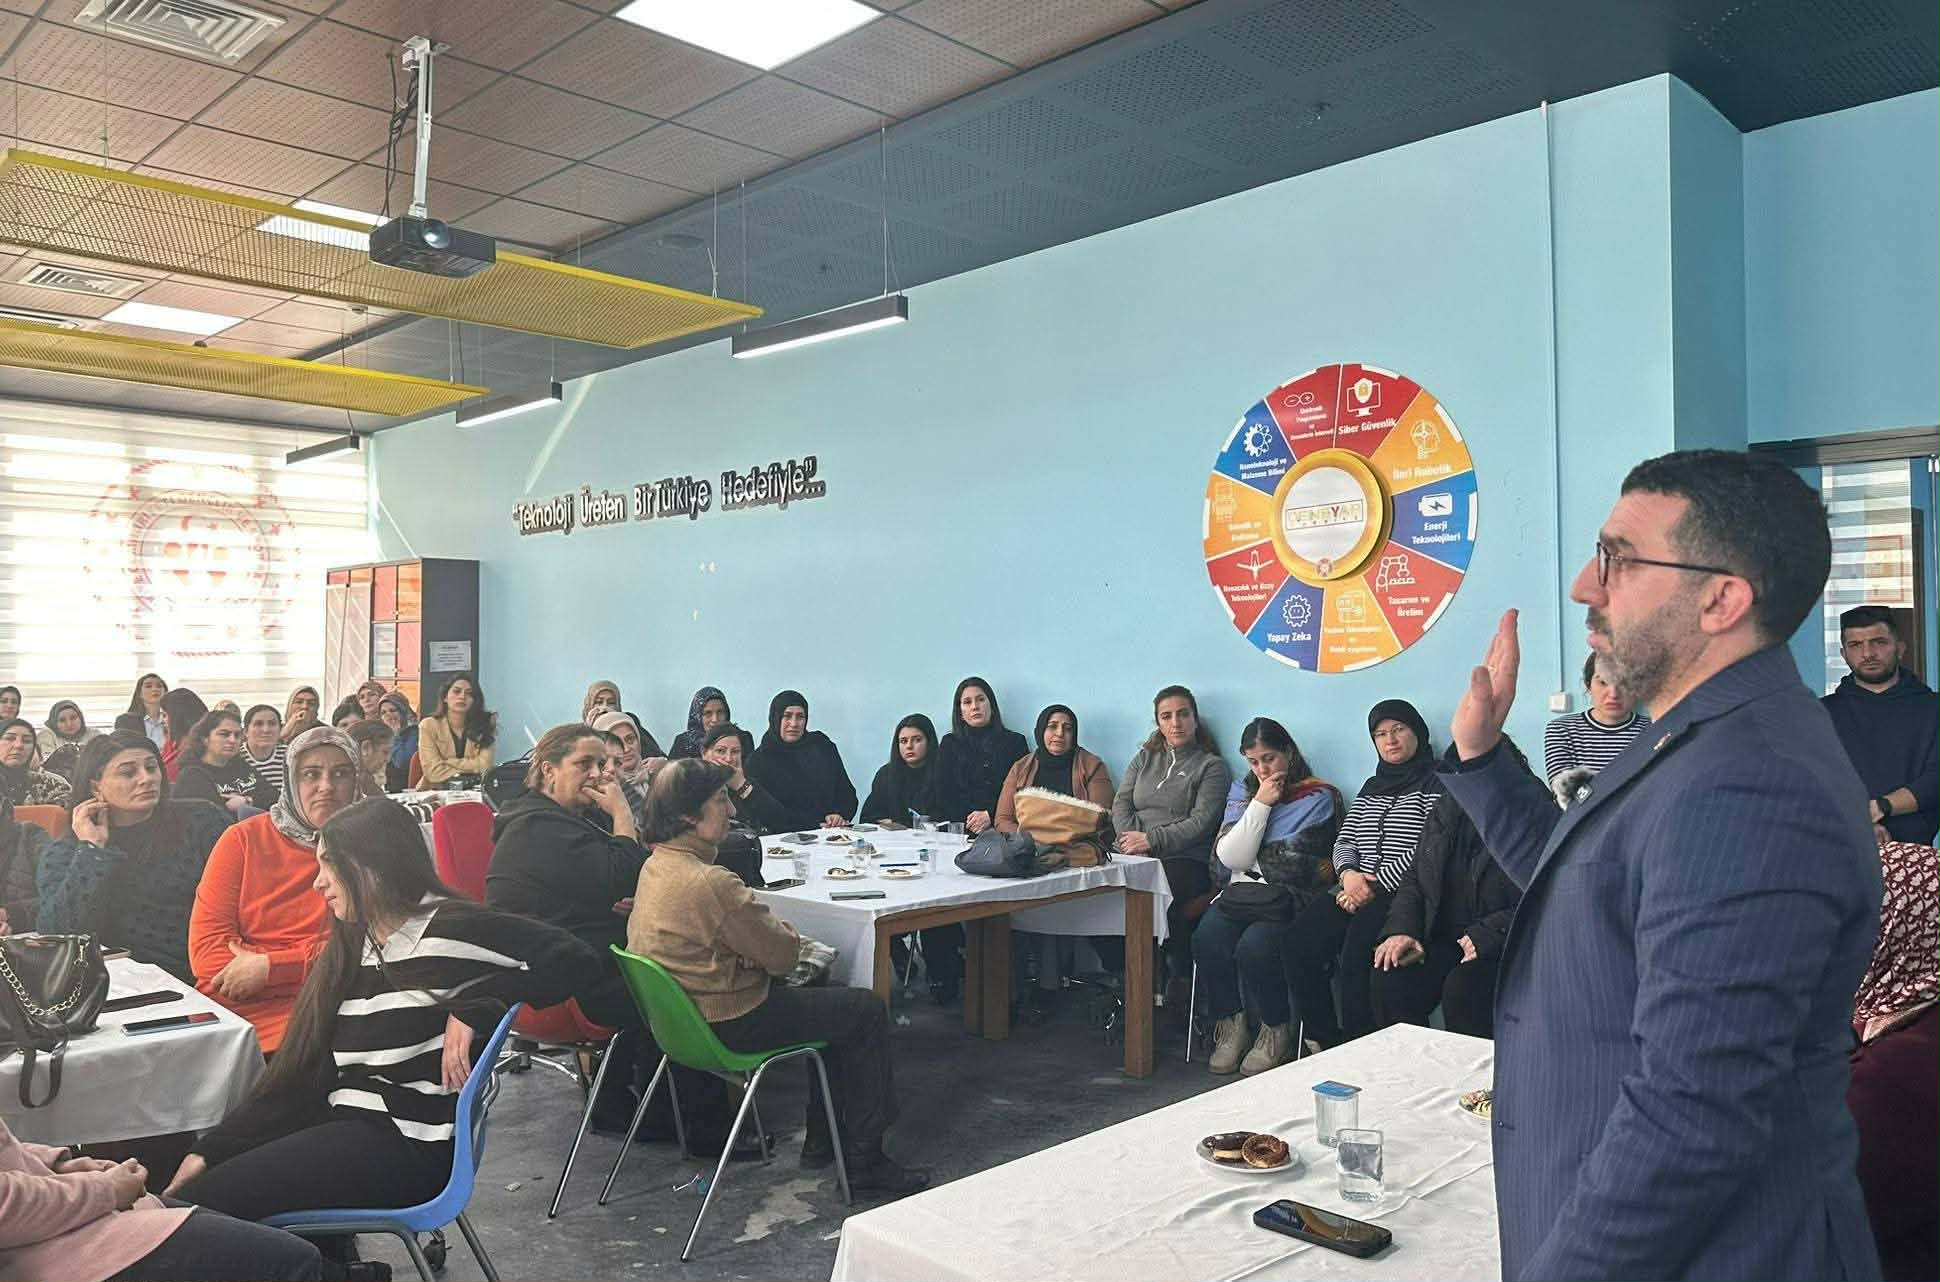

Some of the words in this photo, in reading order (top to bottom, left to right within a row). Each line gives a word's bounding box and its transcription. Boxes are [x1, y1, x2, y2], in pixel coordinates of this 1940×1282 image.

[1338, 423, 1359, 435] Siber
[1360, 416, 1397, 431] Güvenlik
[580, 488, 627, 526] Üreten
[633, 484, 655, 519] Bir
[655, 477, 712, 519] Türkiye
[1424, 521, 1447, 532] Enerji
[1411, 532, 1461, 545] Teknolojileri
[1267, 632, 1290, 644] Yapay
[1291, 631, 1312, 642] Zeka
